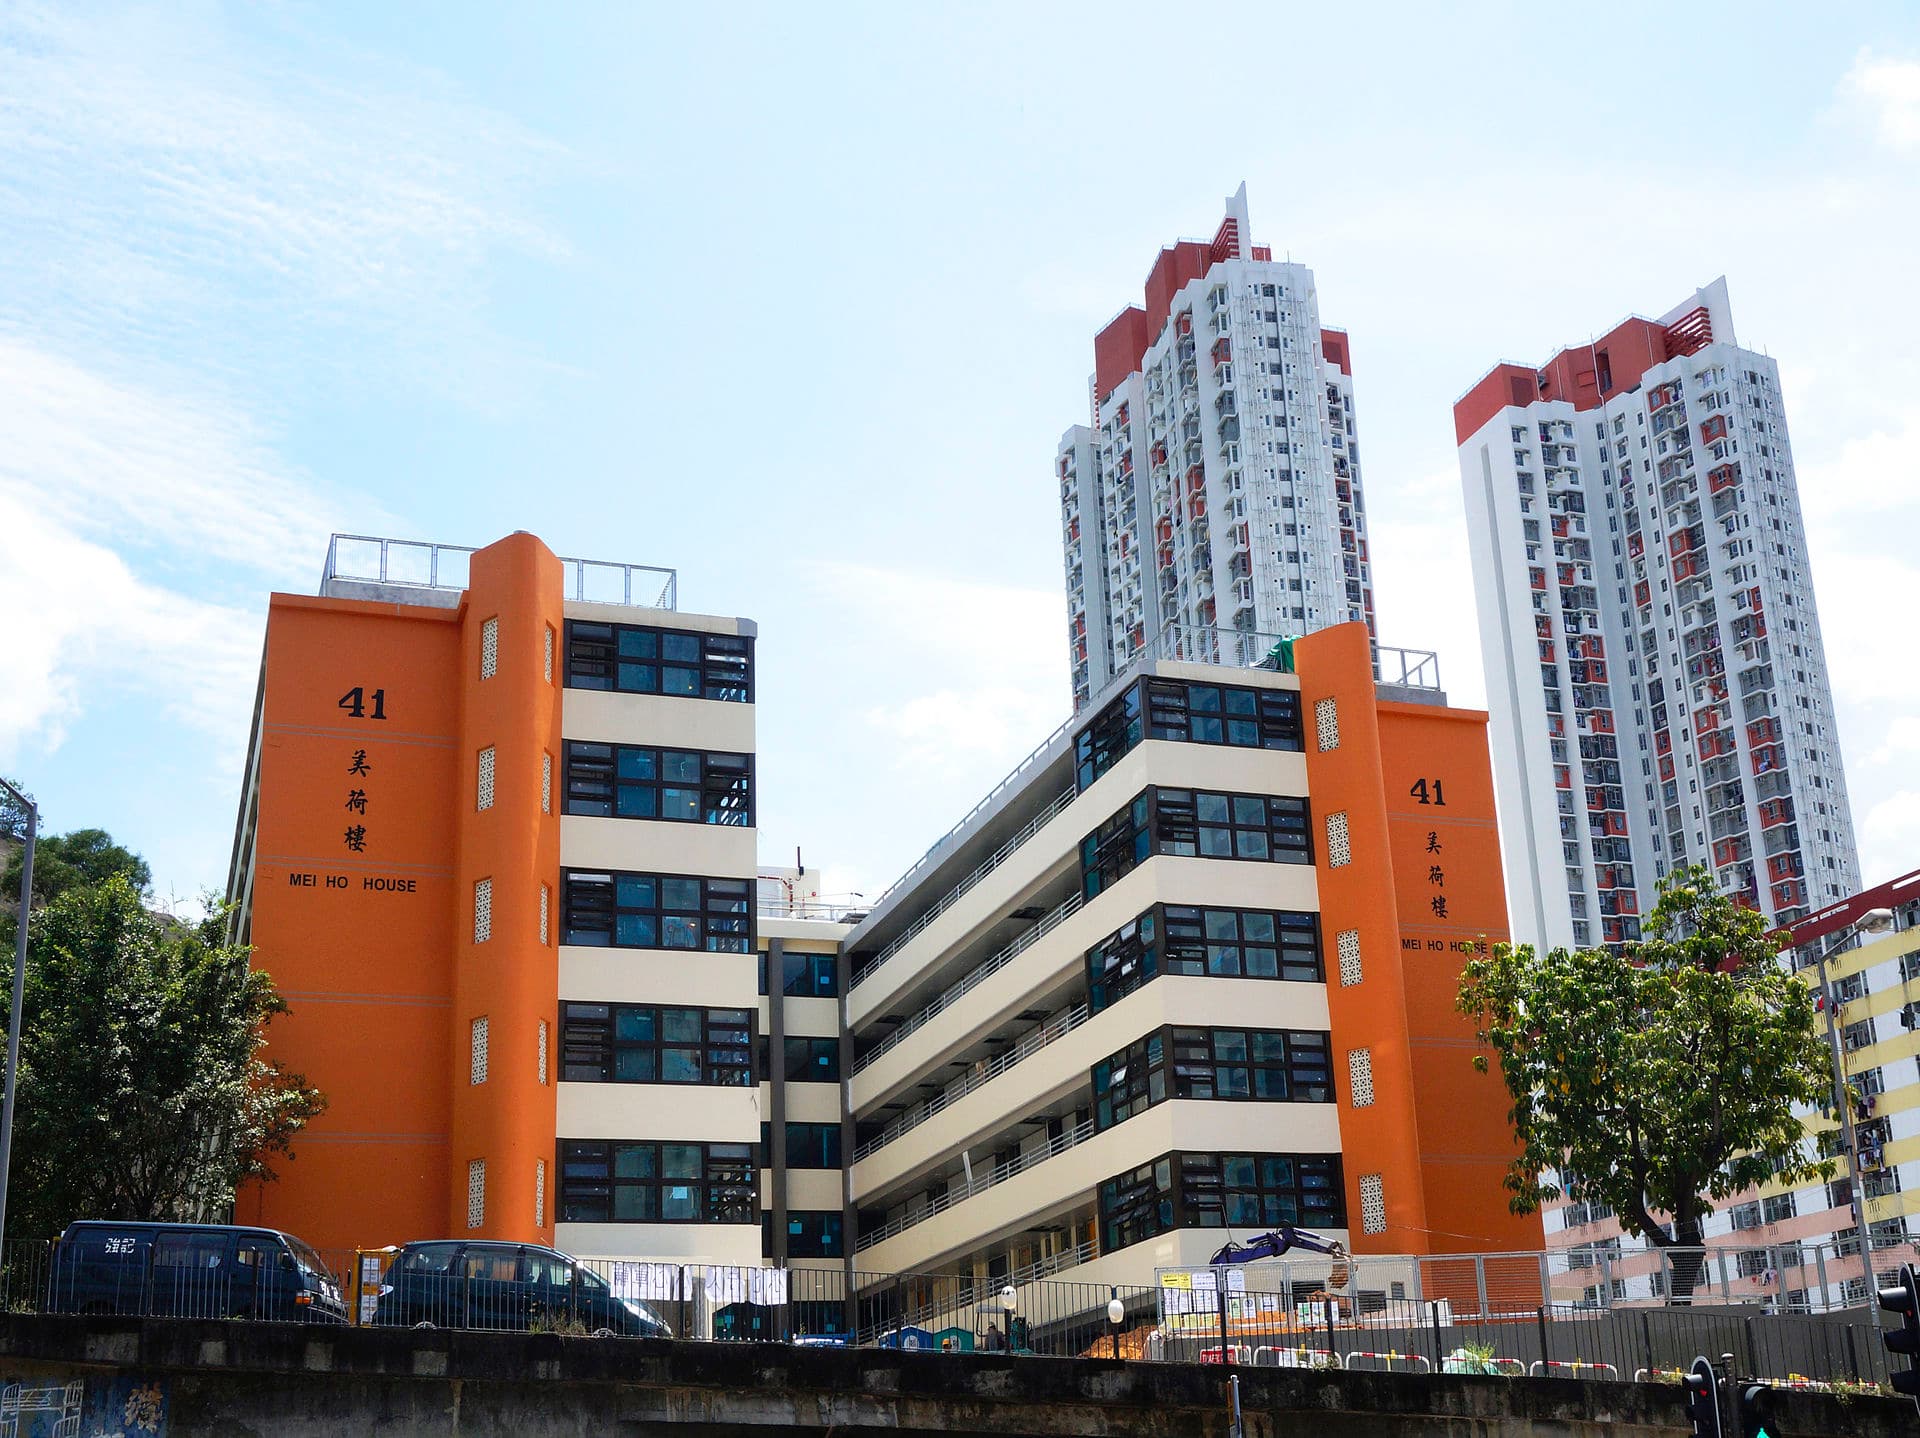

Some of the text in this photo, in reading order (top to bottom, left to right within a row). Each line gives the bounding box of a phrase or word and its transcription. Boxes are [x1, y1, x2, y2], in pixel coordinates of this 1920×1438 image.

[338, 687, 387, 720] 41
[344, 749, 371, 853] 美荷樓
[1410, 778, 1446, 806] 41
[289, 873, 417, 893] MEI HO HOUSE
[1425, 831, 1449, 919] 美荷樓
[1402, 938, 1488, 954] MEI HO HOSE
